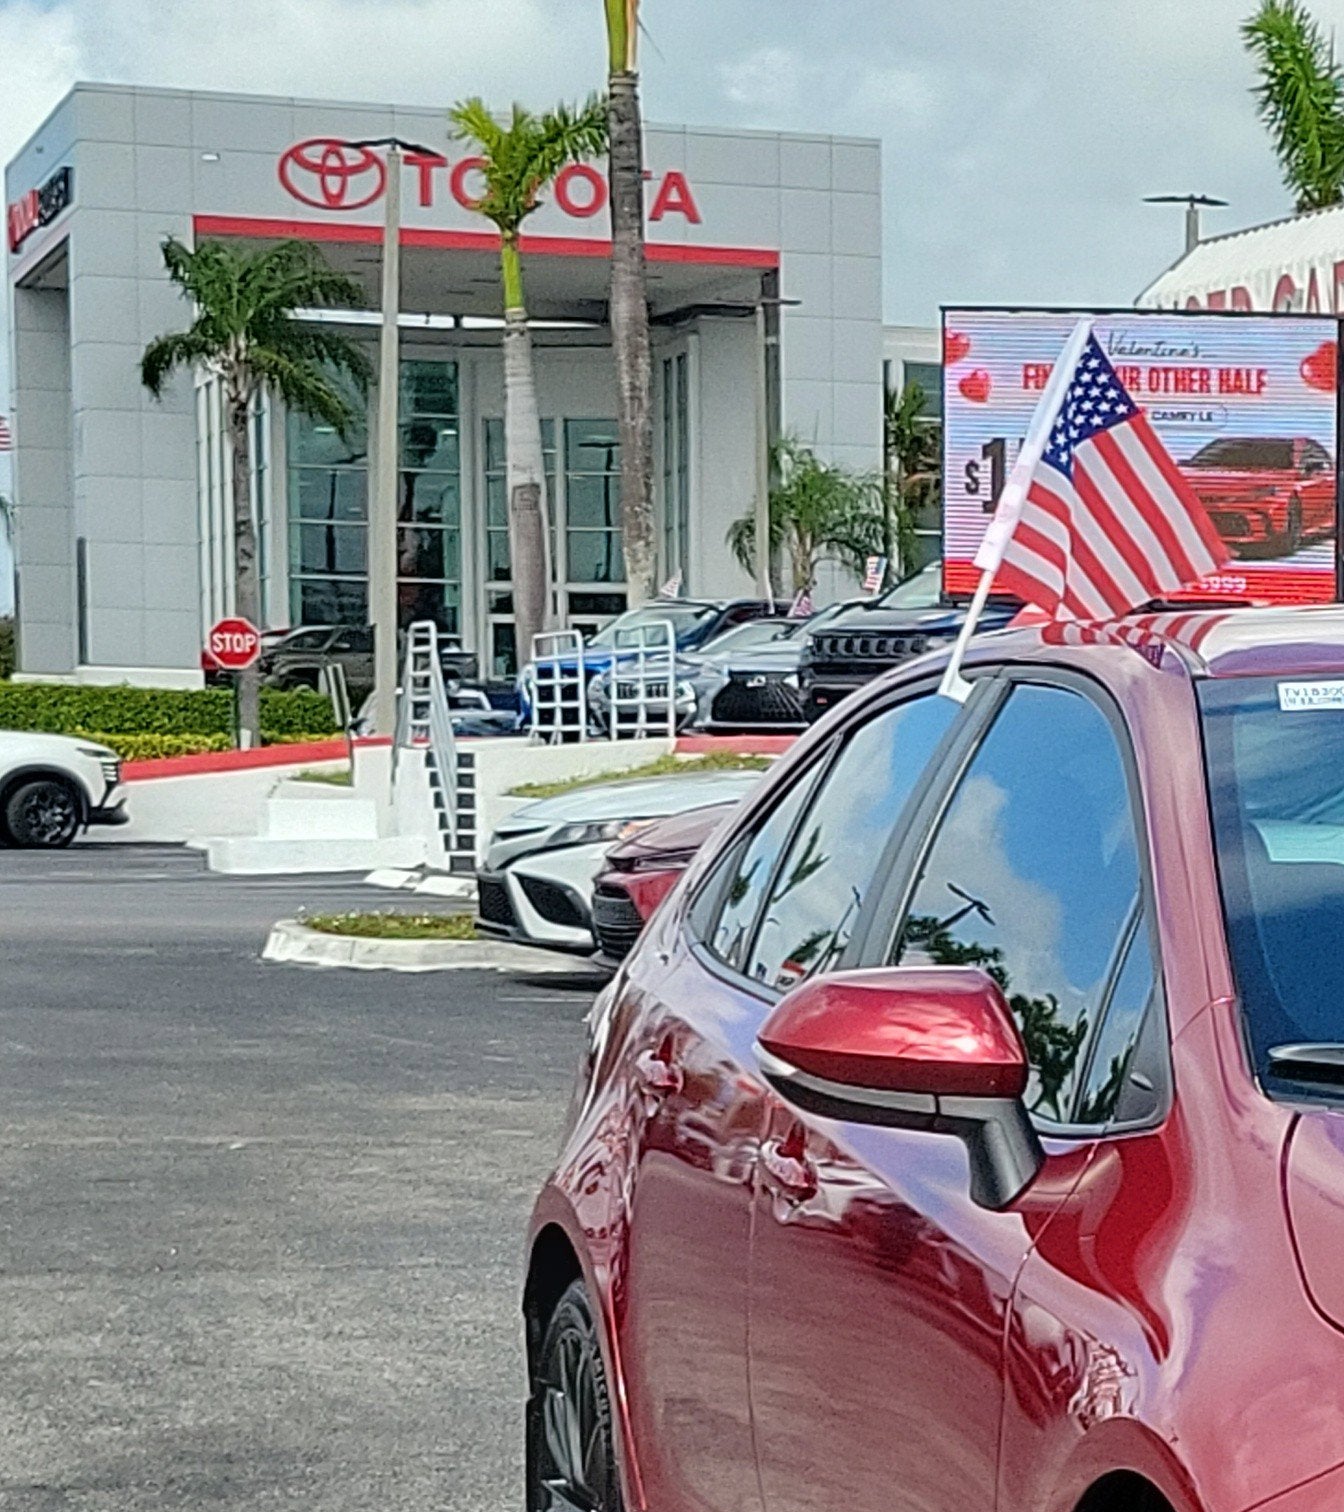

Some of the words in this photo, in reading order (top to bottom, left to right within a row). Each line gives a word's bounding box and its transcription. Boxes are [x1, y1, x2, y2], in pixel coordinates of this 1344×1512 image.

[403, 153, 702, 224] TOOA
[1149, 366, 1211, 394] OTHER
[1218, 367, 1268, 395] HALF
[1151, 410, 1197, 422] CAMRY
[212, 632, 256, 653] STOP
